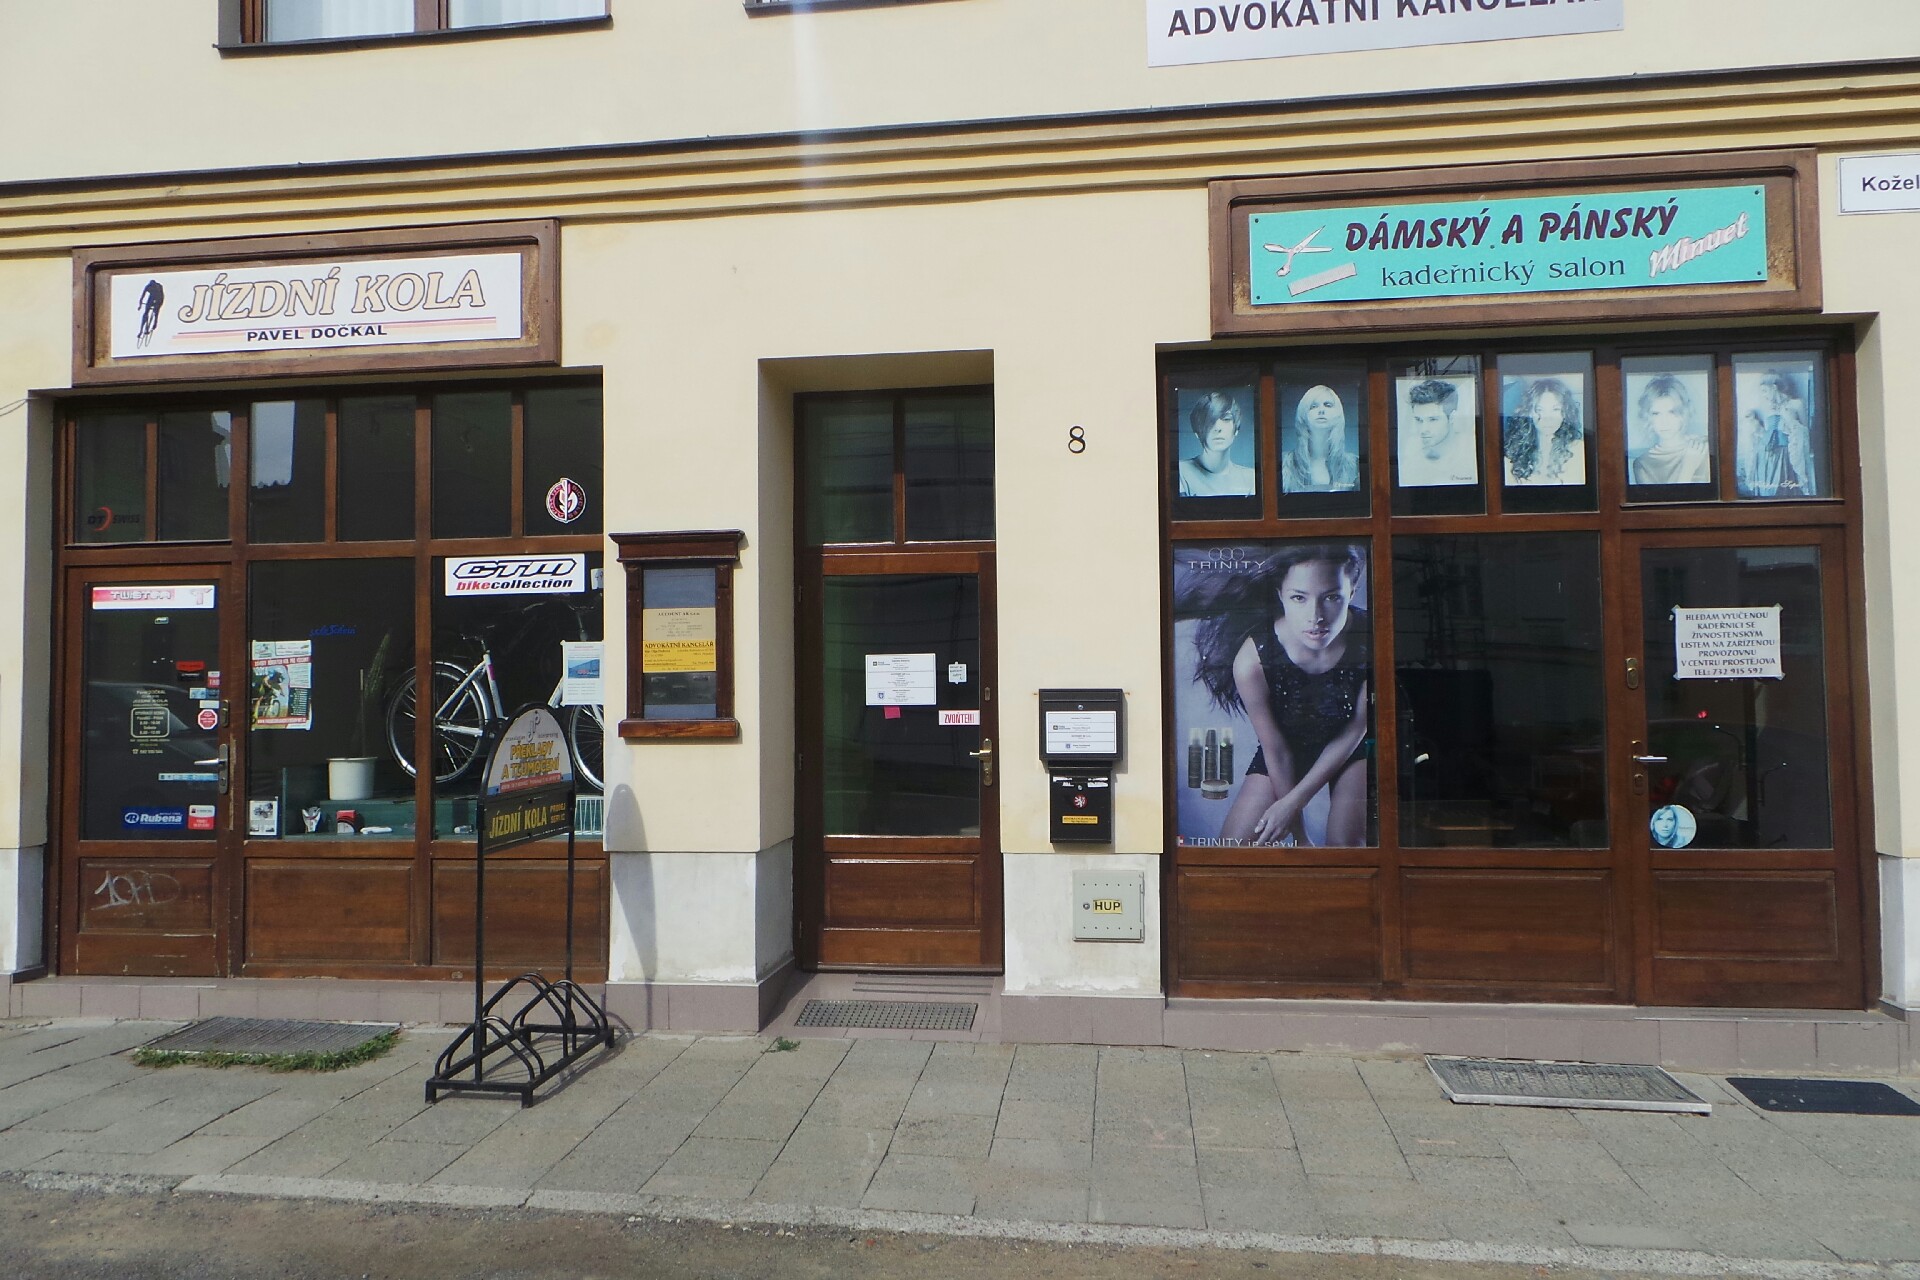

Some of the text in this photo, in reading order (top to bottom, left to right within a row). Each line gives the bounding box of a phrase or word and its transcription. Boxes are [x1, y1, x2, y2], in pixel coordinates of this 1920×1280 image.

[1345, 197, 1679, 251] DÁMSKÝ A PÁNSKÝ
[1649, 211, 1750, 278] Minuet
[1382, 257, 1626, 287] kadeřnický salon
[177, 267, 486, 323] JÍZDNÍ KOLA
[247, 323, 388, 342] PAVEL DOČKAL
[1068, 425, 1086, 454] 8
[453, 558, 577, 579] CTM
[1187, 560, 1266, 570] TRINITY
[456, 578, 573, 591] bikecollection
[1681, 641, 1710, 649] LISTEM
[1698, 649, 1757, 657] PROVOZOVNU
[510, 740, 554, 760] PŘEKLADY
[501, 763, 510, 780] A
[140, 813, 183, 823] Rubena
[489, 805, 548, 839] JÍZDNÍ KOLA
[1189, 837, 1243, 847] TRINITY
[1094, 901, 1121, 911] HUP
